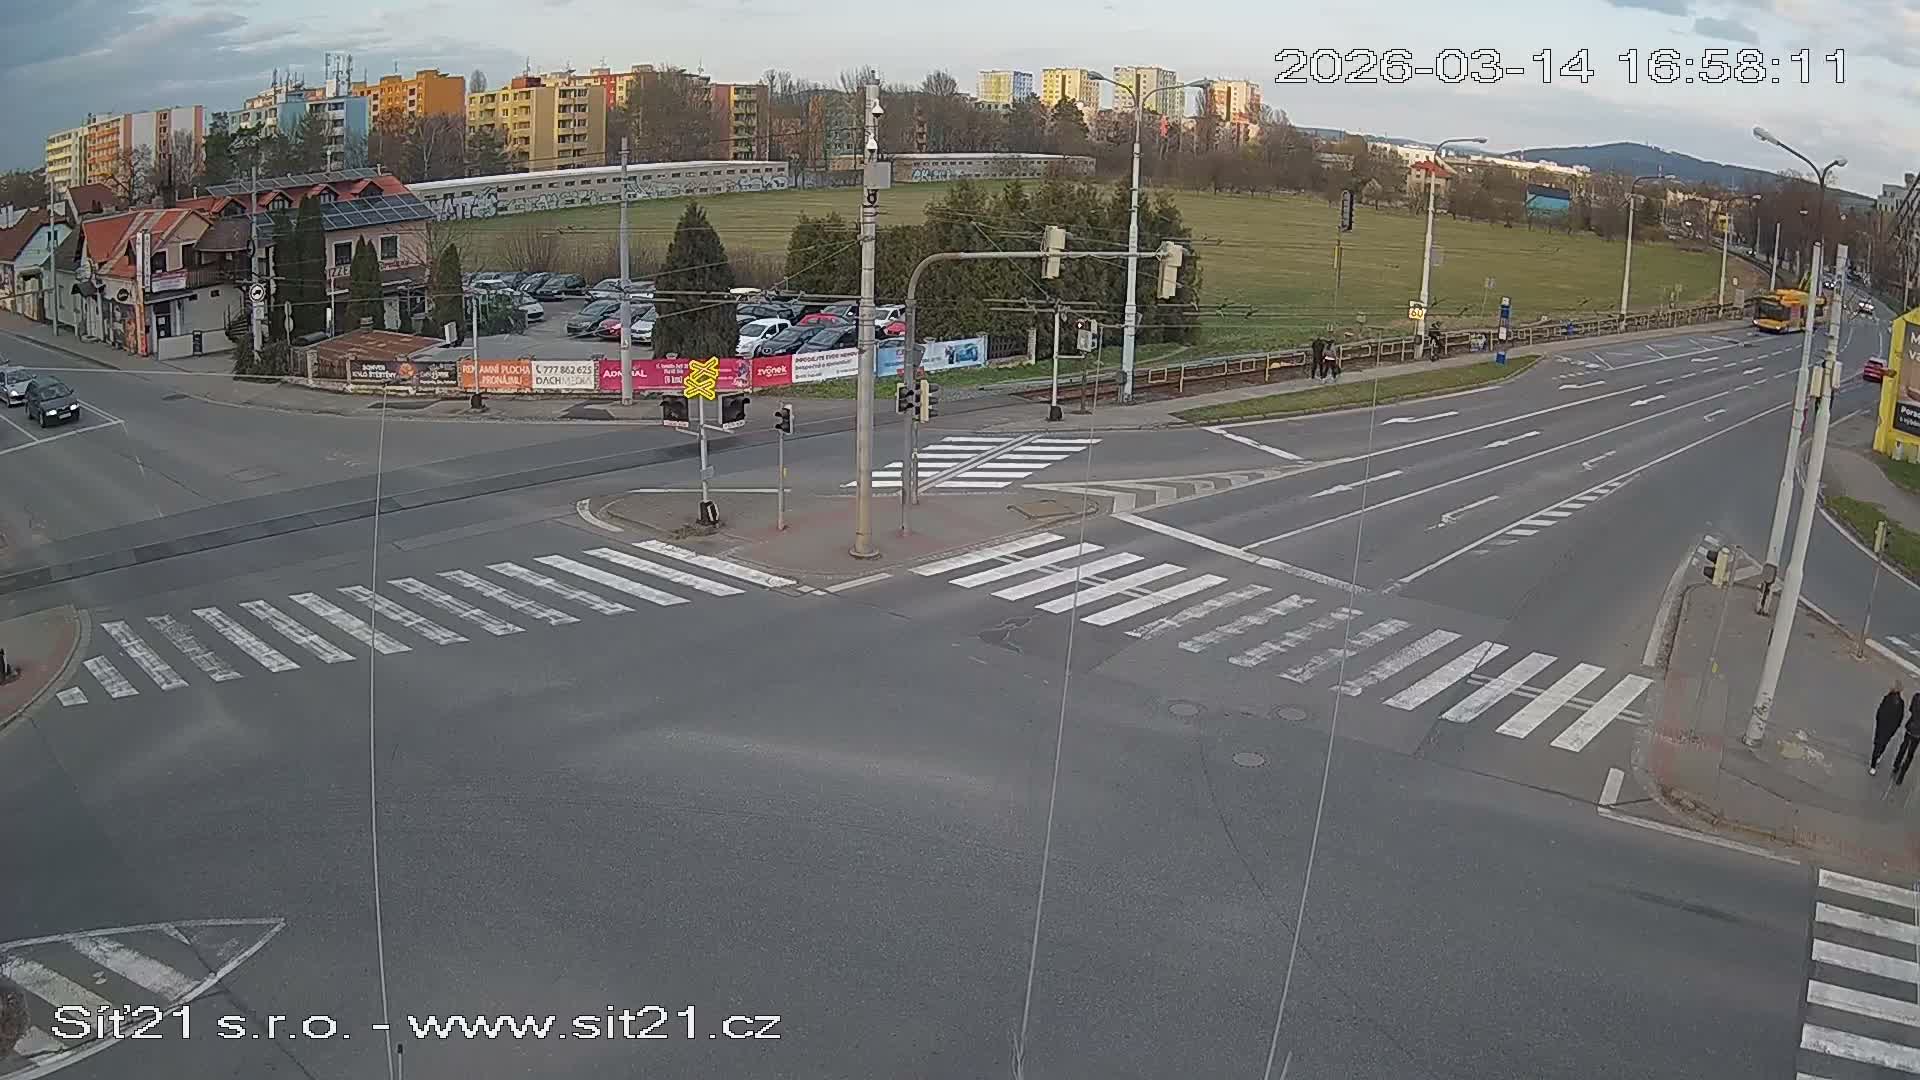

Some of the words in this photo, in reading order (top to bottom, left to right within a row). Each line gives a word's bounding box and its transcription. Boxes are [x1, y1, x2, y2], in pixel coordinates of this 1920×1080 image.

[463, 364, 500, 374] REKAMNÍ
[501, 364, 531, 375] PLOCHA
[543, 365, 559, 374] 777
[560, 365, 576, 374] 862
[576, 365, 592, 374] 625
